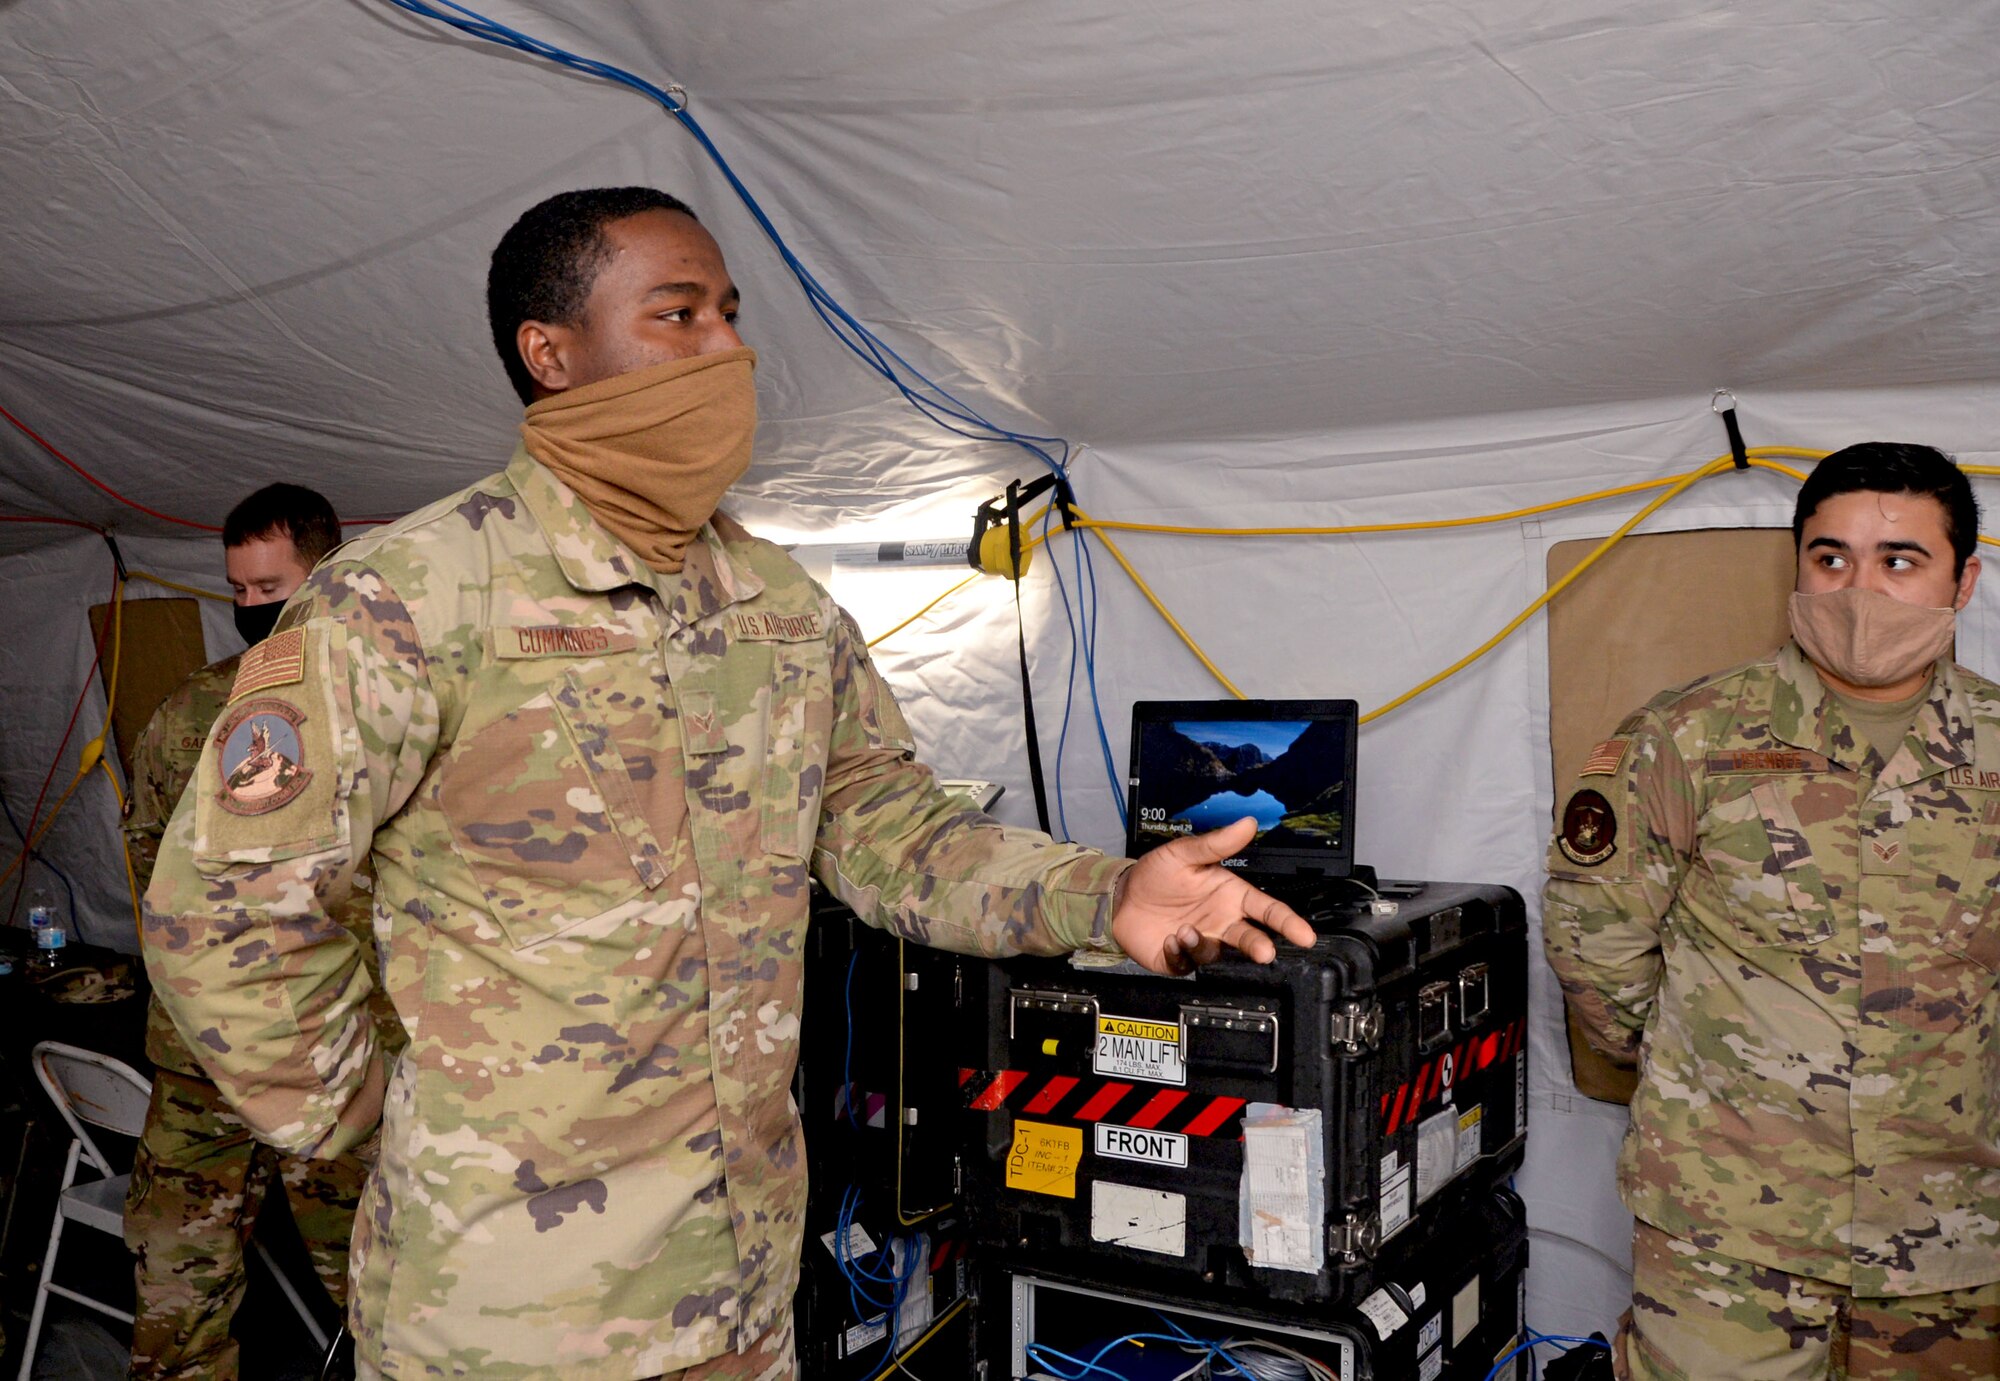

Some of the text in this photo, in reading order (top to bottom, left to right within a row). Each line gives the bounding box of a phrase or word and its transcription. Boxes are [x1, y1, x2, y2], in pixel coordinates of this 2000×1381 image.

[736, 613, 764, 635] U.S.
[518, 626, 608, 653] CUMMINGS
[1950, 767, 1977, 787] U.S.
[1141, 808, 1166, 821] 9:00
[1141, 822, 1193, 832] Thursday, April 29
[1220, 858, 1248, 867] Getac
[1117, 1022, 1174, 1040] CAUTION
[1100, 1036, 1179, 1066] 2 MAN LIFT
[1010, 1129, 1031, 1178] TDC-1
[1107, 1130, 1176, 1159] FRONT
[1419, 1321, 1434, 1350] TOP
